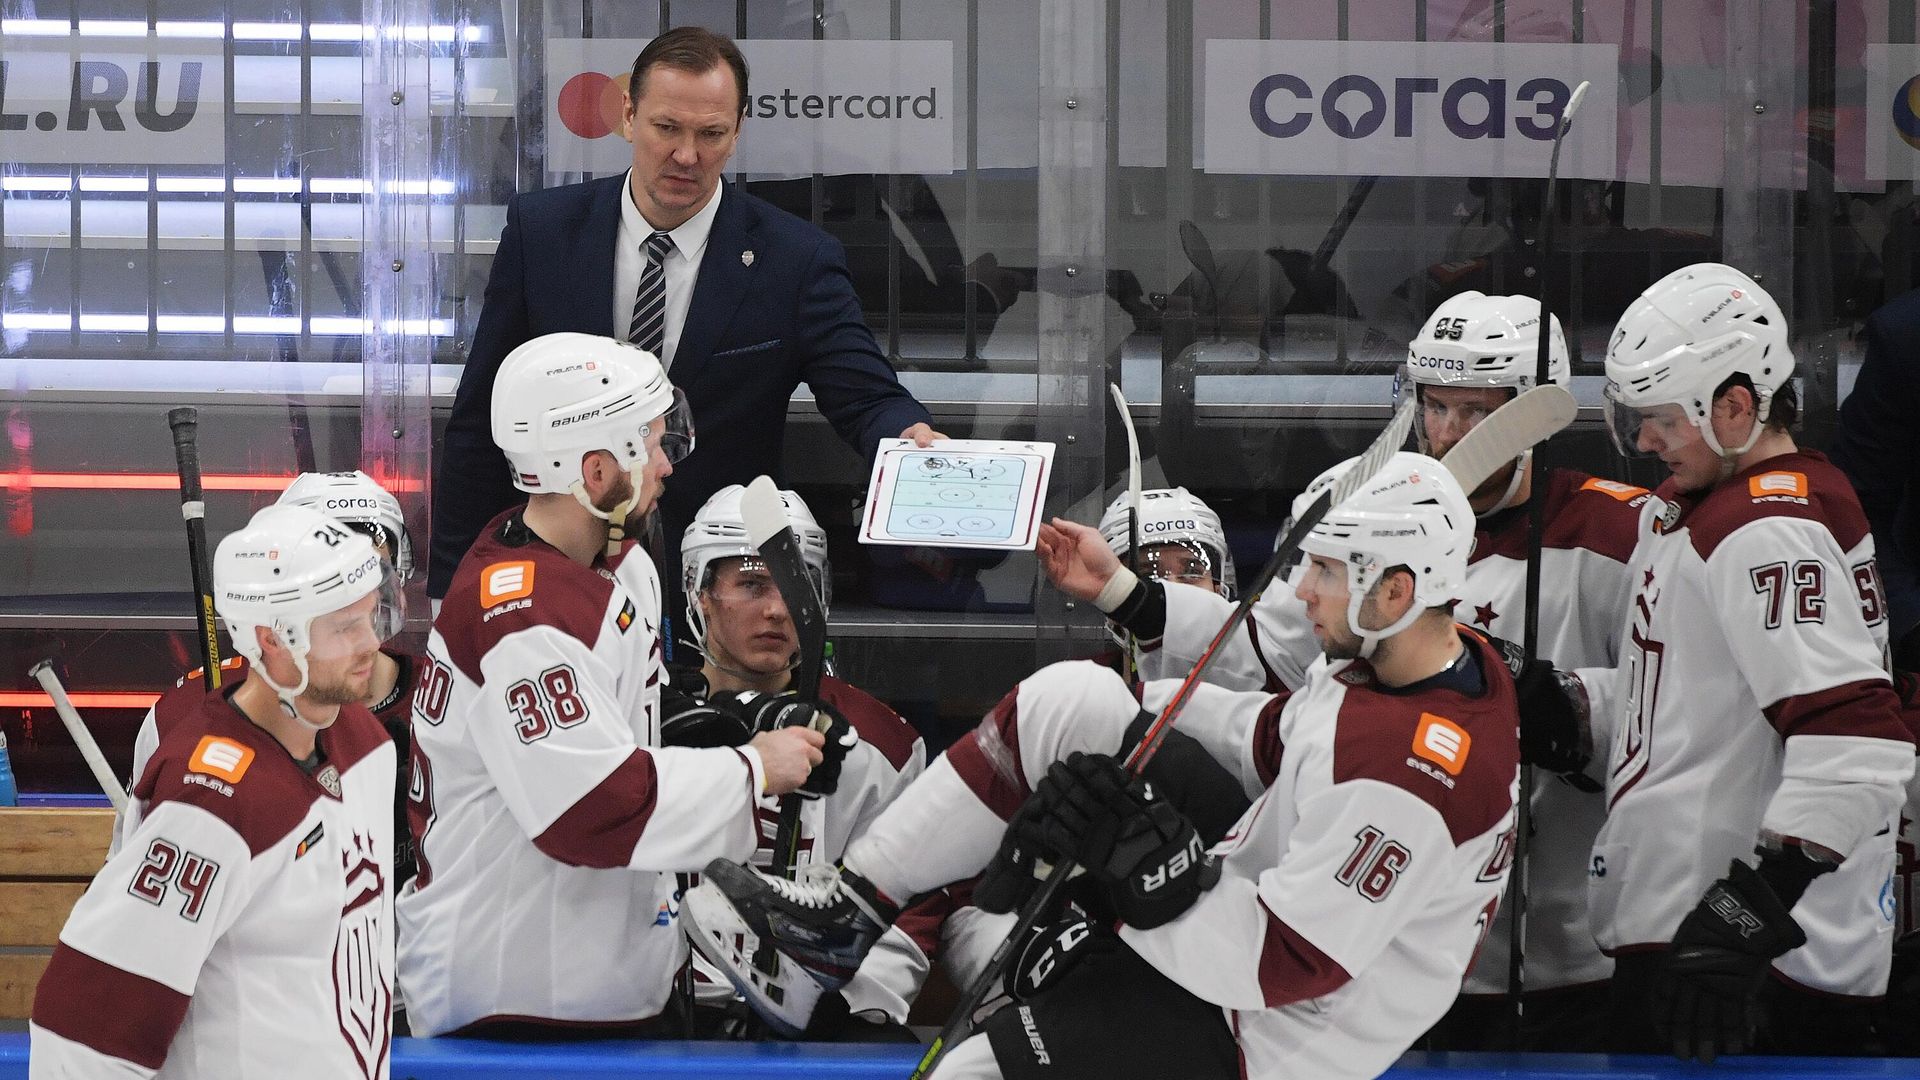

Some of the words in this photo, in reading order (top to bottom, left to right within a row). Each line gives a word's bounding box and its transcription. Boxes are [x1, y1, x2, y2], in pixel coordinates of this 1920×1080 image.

[551, 409, 600, 428] BAUER
[314, 524, 349, 548] 24
[226, 592, 266, 603] BAUER
[1750, 559, 1827, 630] 72
[505, 663, 591, 745] 38
[183, 773, 235, 798] EVELATUS
[128, 836, 220, 923] 24
[1141, 828, 1204, 892] UER
[1335, 824, 1412, 904] 16
[1018, 1005, 1051, 1067] BAUER
